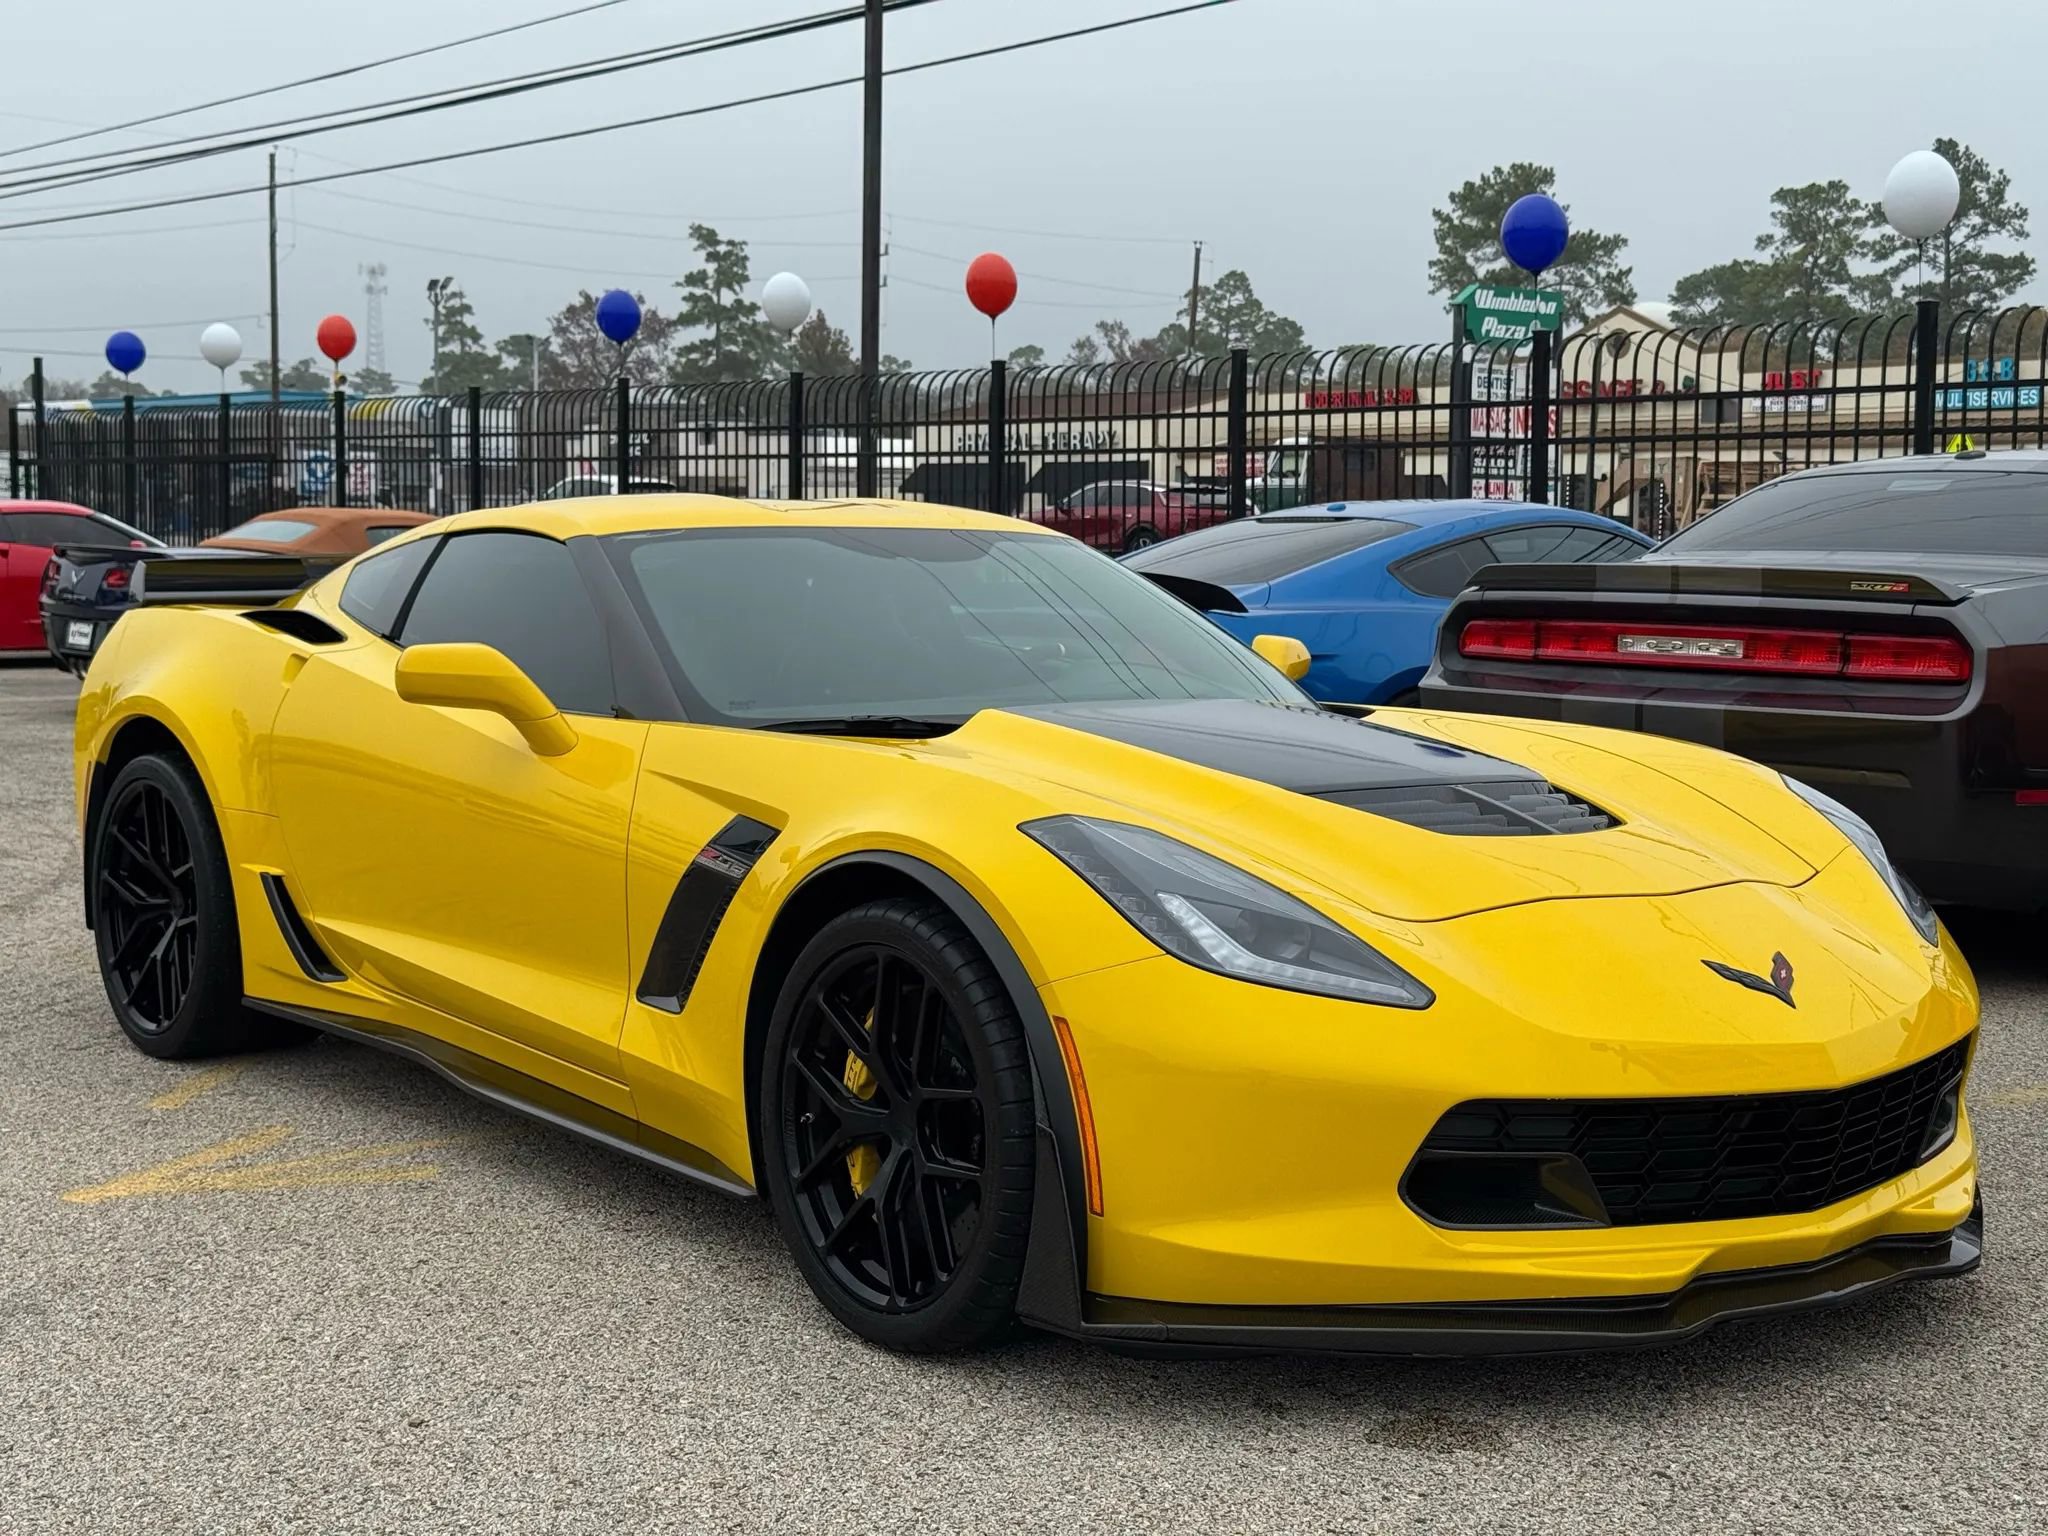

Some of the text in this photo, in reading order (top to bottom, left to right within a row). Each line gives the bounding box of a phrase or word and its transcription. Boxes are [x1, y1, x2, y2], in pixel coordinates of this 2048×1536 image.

[1474, 288, 1558, 315] Wimbledon
[1481, 316, 1527, 339] Plaza
[1621, 638, 1738, 653] DODGE
